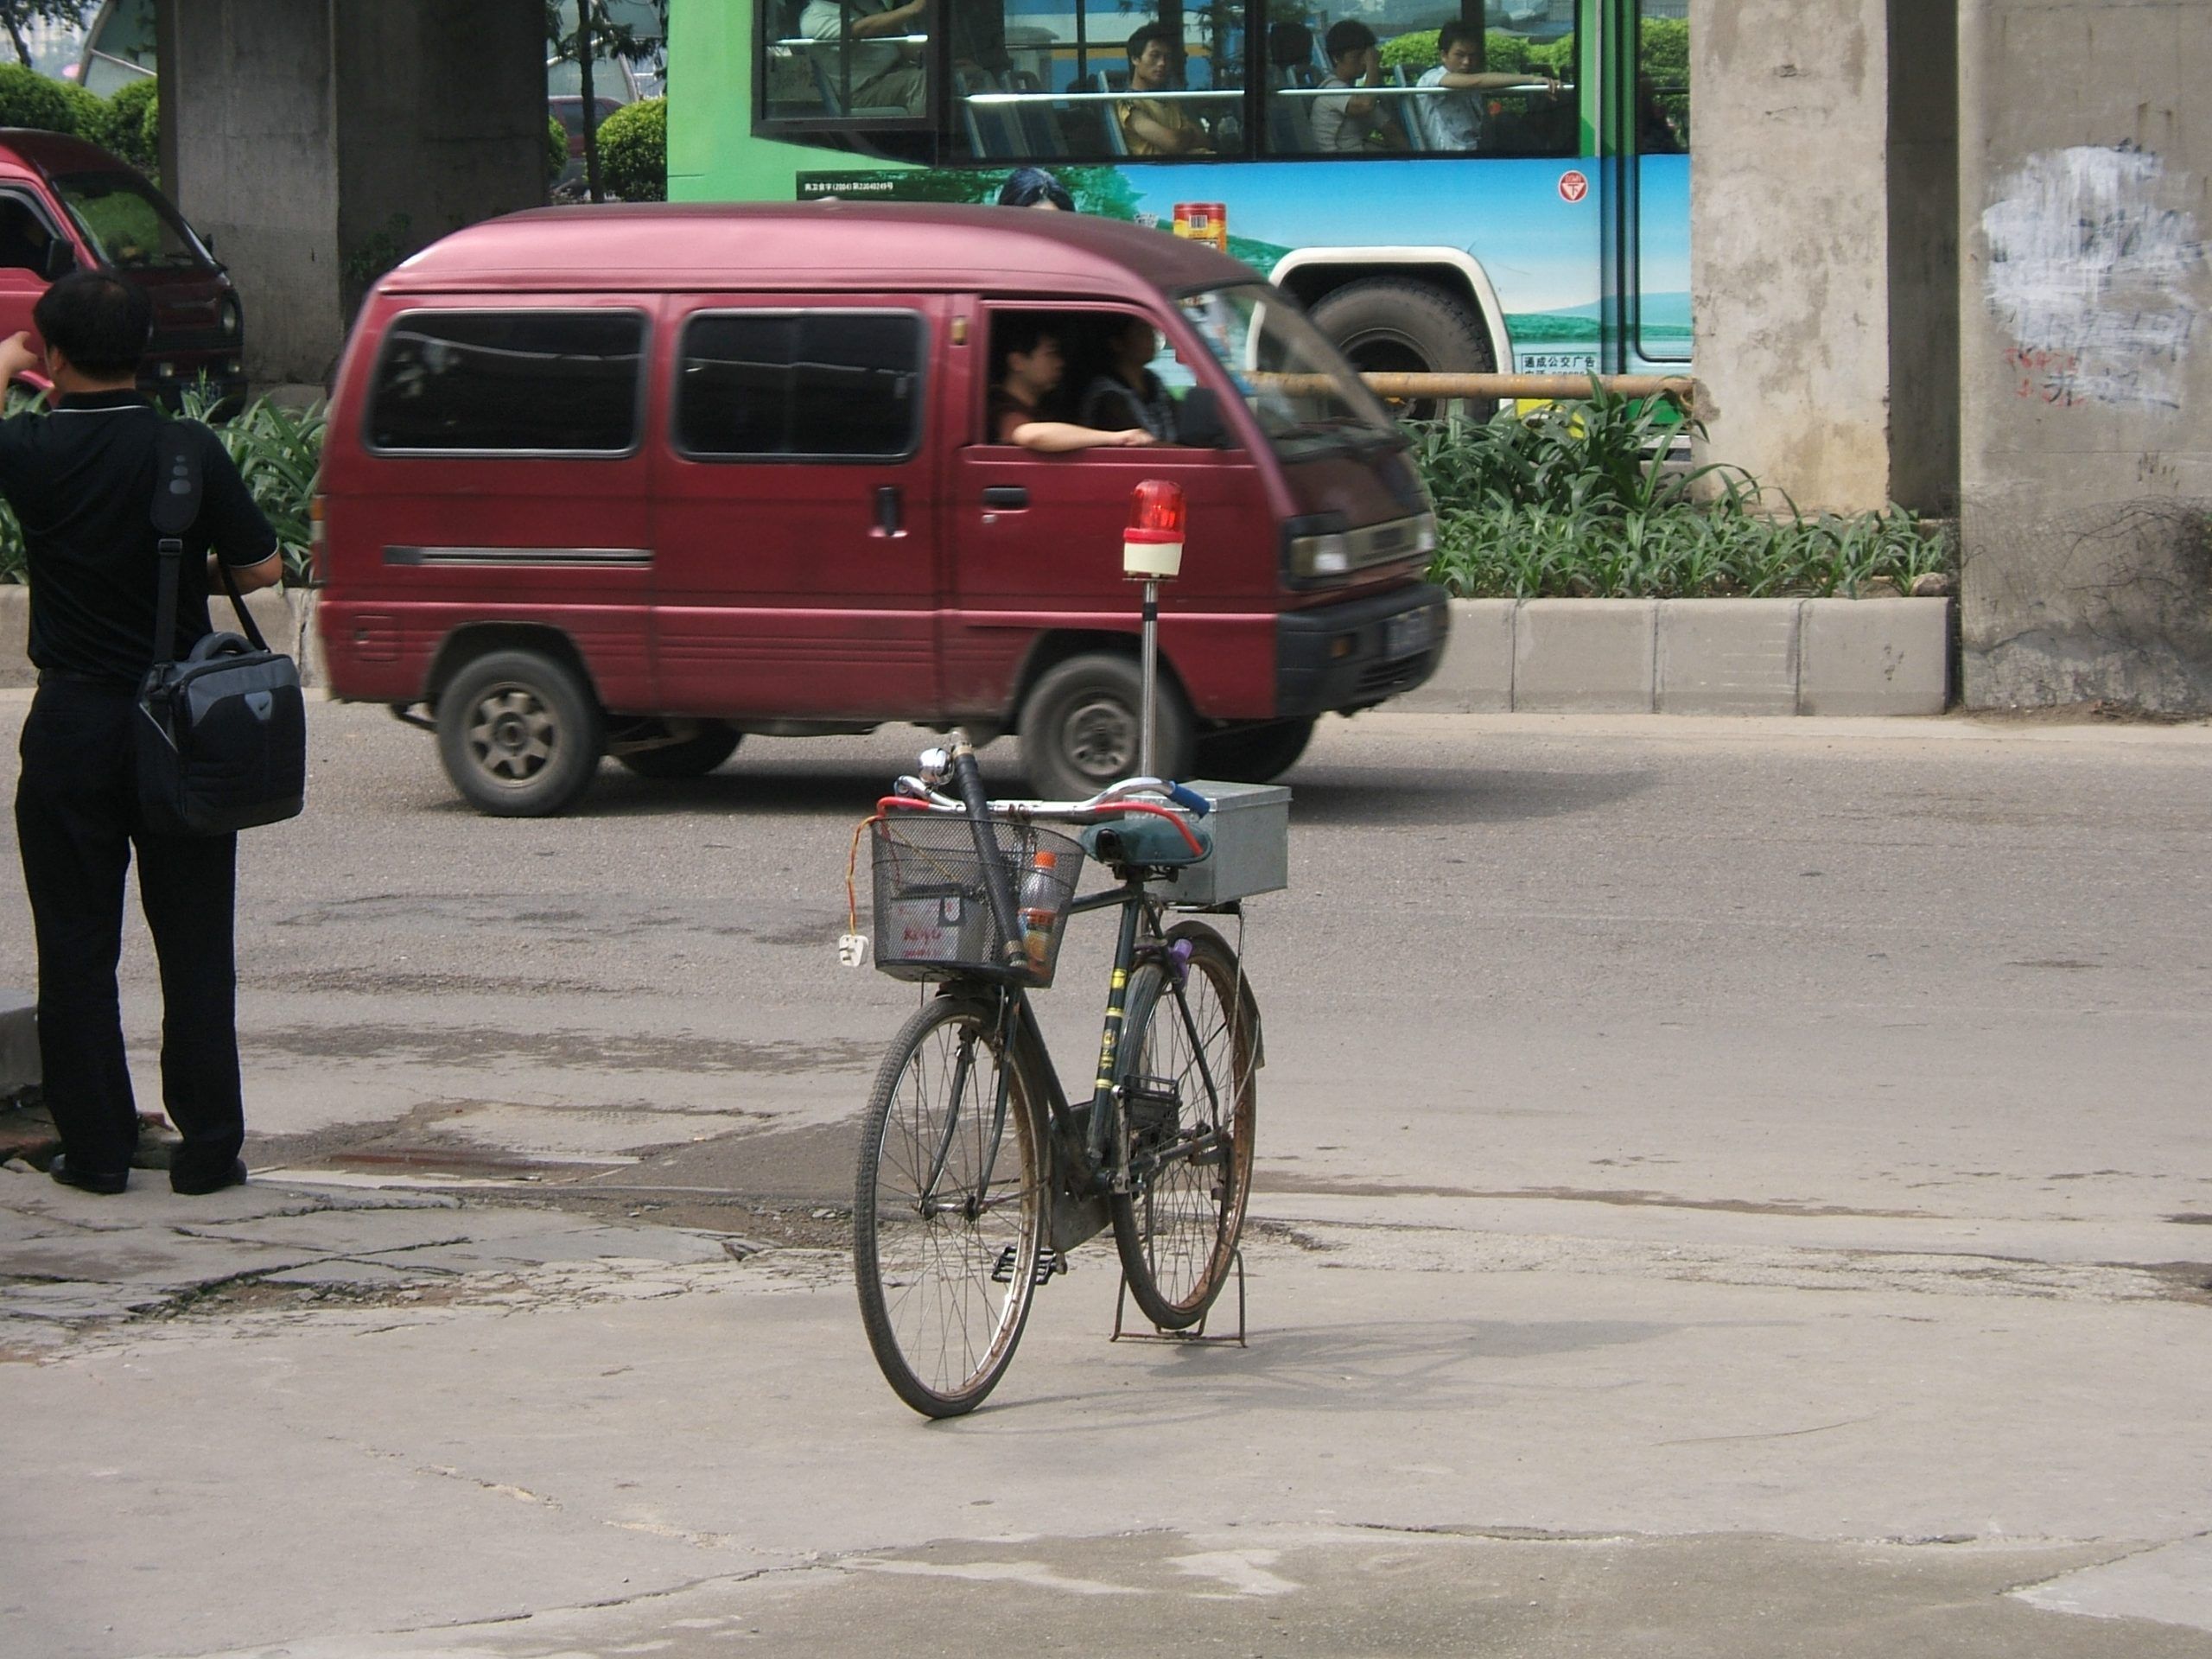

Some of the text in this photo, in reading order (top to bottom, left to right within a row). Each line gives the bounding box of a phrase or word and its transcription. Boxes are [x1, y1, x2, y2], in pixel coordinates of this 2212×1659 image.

[1524, 356, 1596, 368] 通成公交广告
